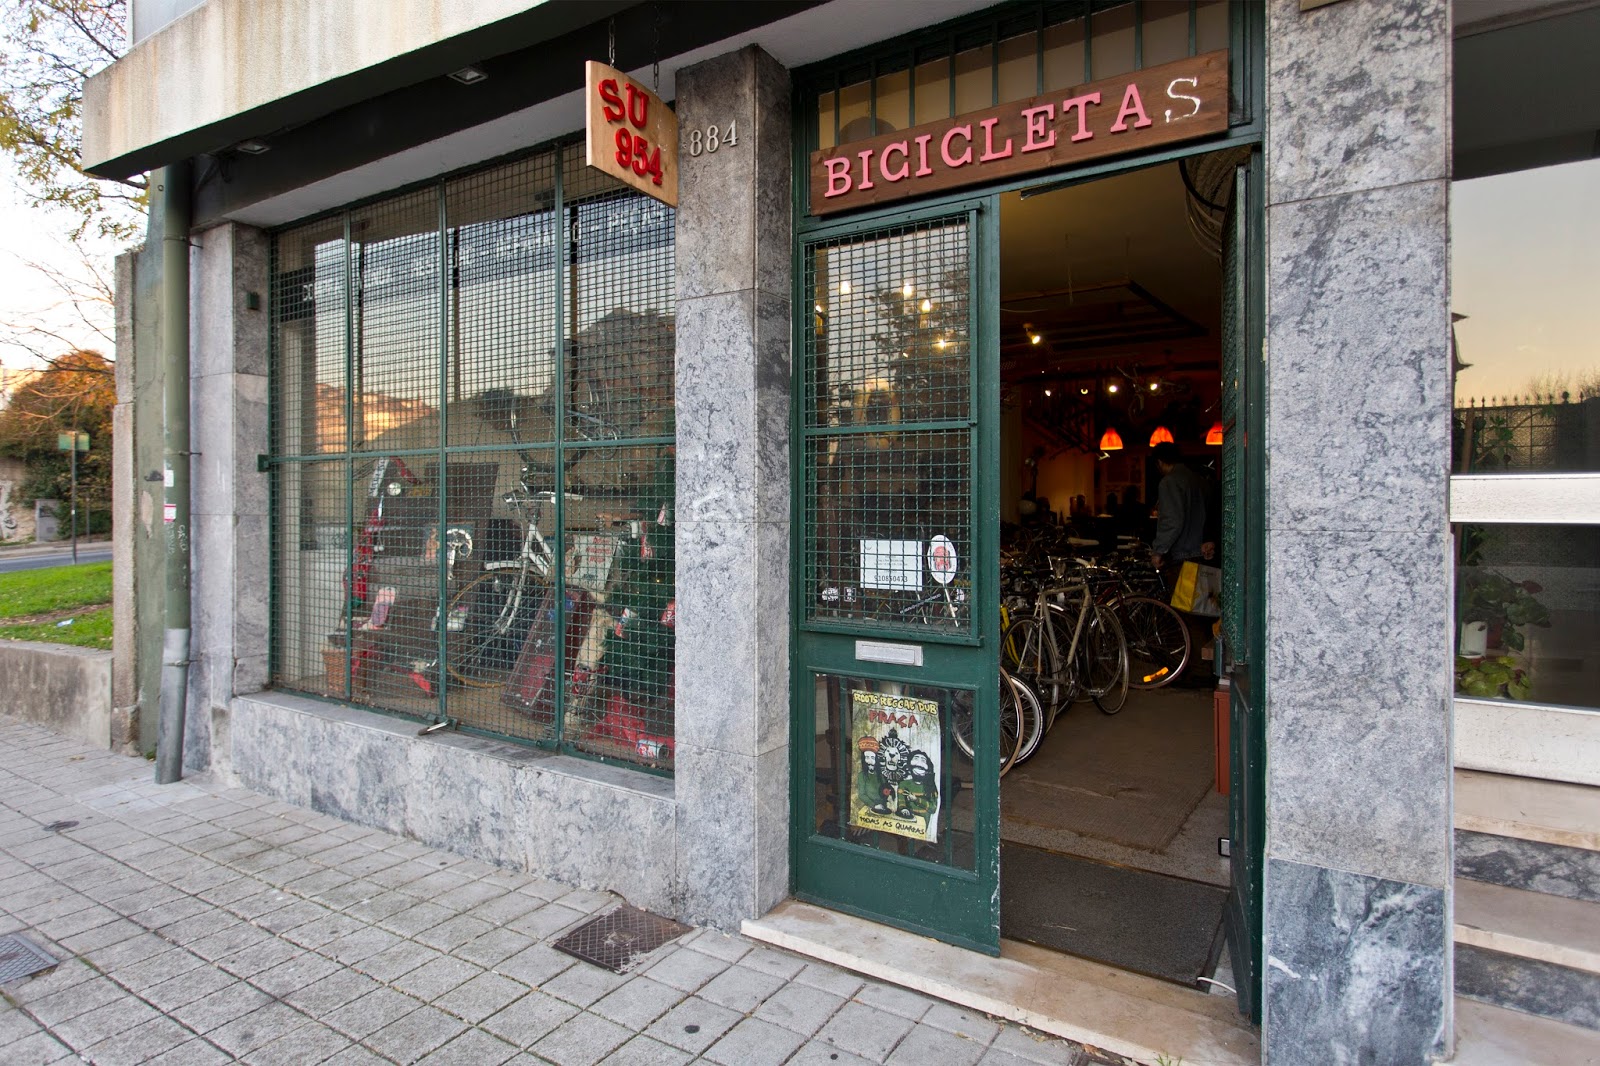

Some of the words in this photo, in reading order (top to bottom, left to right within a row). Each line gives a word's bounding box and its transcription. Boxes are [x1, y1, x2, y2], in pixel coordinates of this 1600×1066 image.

[598, 78, 649, 129] SU
[690, 120, 739, 157] 884
[823, 77, 1202, 198] BICICLETAS
[615, 127, 664, 186] 954
[853, 691, 879, 704] ROOTS
[880, 696, 917, 712] REGGAE
[917, 701, 938, 716] DUB
[869, 709, 919, 729] PRAÇA
[859, 816, 880, 826] TODAS
[883, 820, 893, 828] AS
